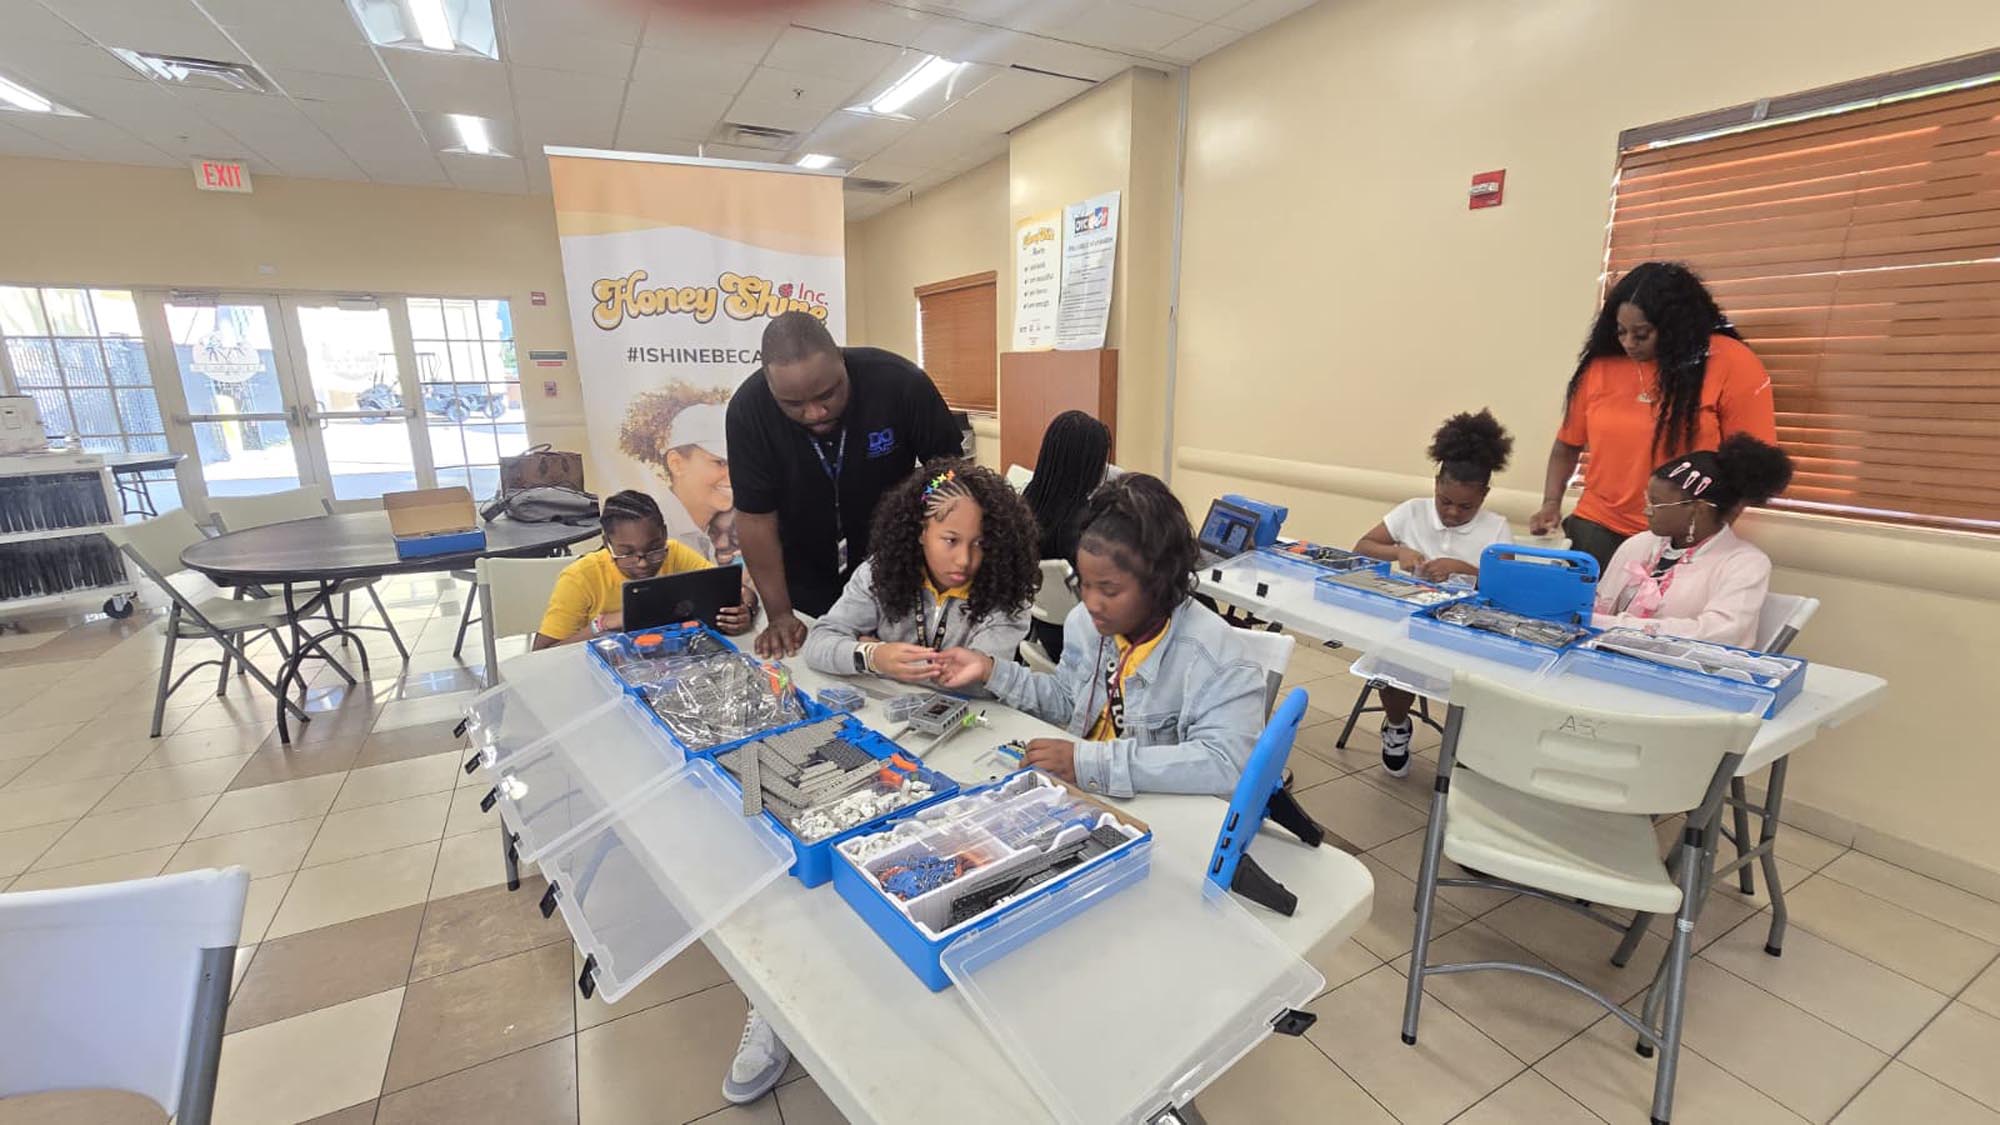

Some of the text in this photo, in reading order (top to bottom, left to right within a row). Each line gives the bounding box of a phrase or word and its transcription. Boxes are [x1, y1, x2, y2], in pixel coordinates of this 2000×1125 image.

[202, 163, 241, 188] EXIT
[592, 270, 828, 330] Honey Shine
[798, 284, 828, 305] Inc.
